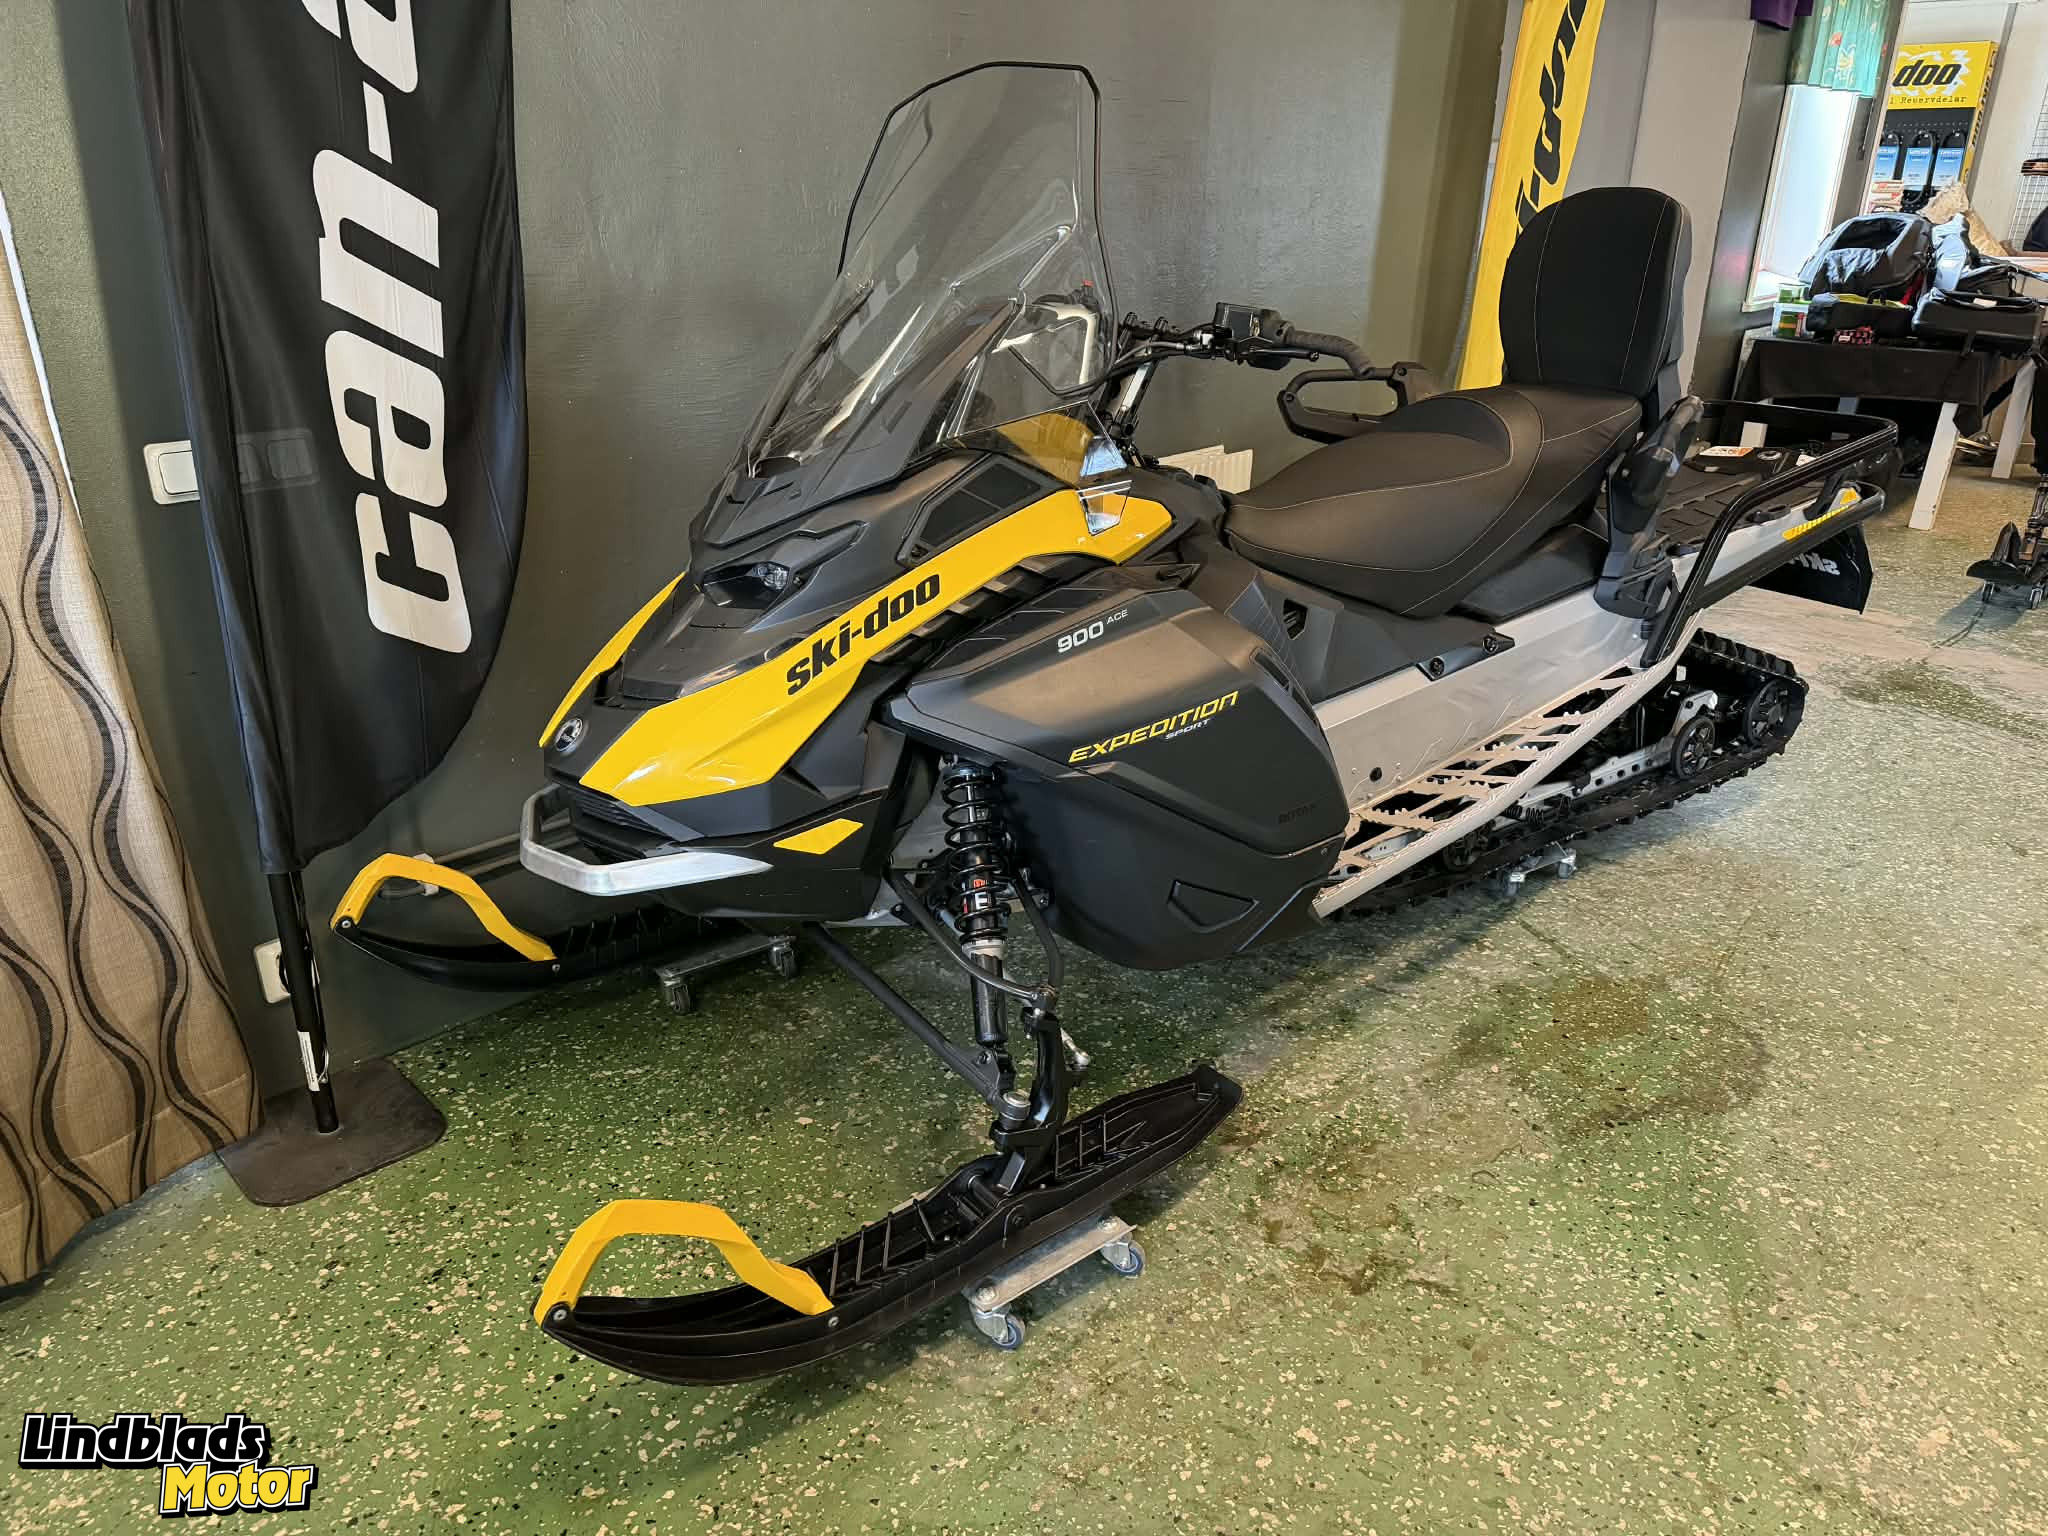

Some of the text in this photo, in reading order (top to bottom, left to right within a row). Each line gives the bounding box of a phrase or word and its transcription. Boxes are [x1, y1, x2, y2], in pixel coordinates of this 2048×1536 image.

[787, 574, 940, 696] ski-doo
[1057, 608, 1129, 654] 900 ACE
[1068, 690, 1239, 763] EXPEDITION
[1165, 718, 1210, 740] SPORT
